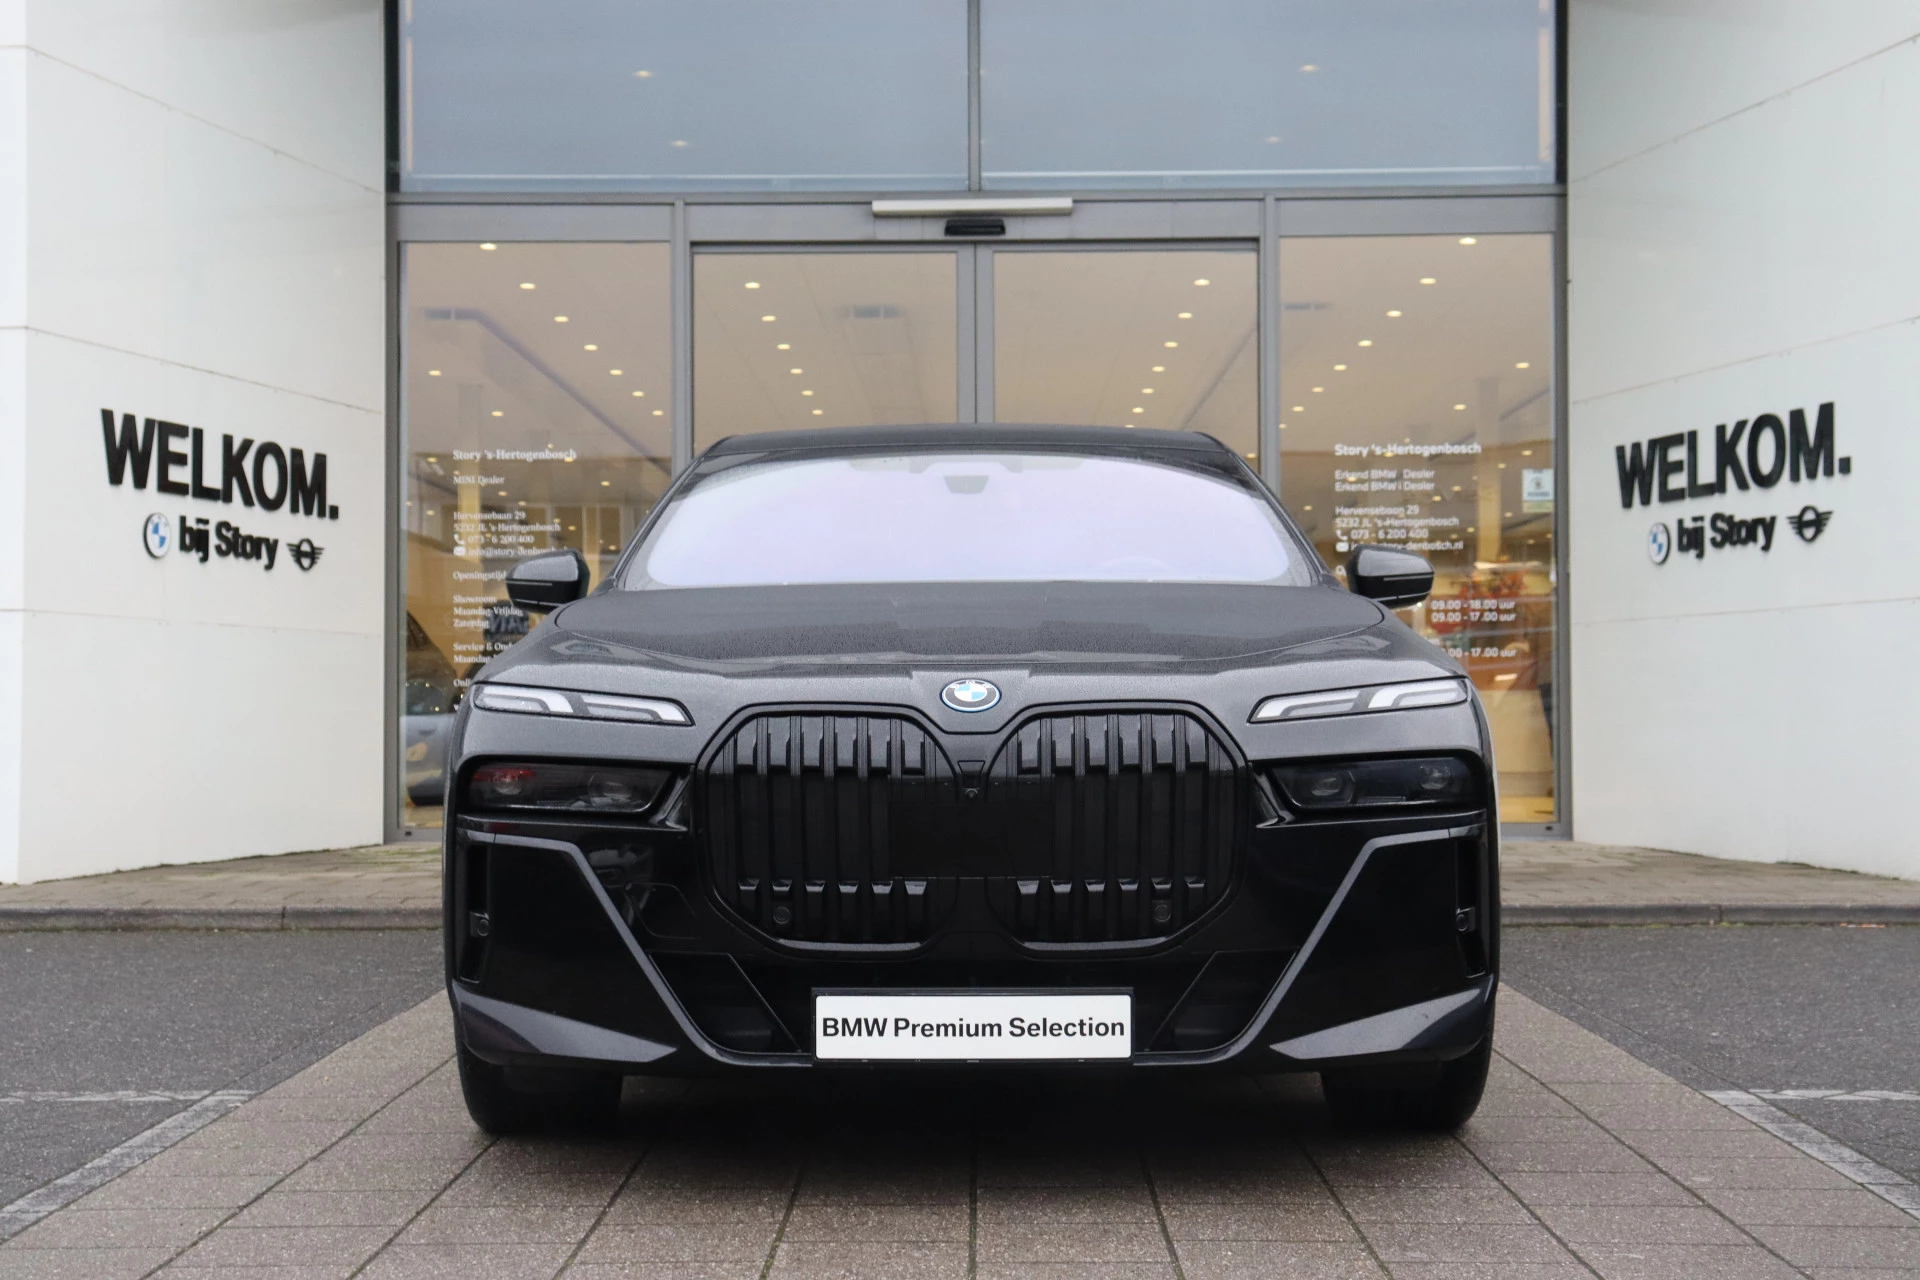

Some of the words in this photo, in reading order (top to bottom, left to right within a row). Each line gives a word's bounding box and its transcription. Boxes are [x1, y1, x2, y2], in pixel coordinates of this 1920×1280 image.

[452, 449, 481, 462] Story
[1334, 443, 1369, 457] Story
[1615, 401, 1852, 509] WELKOM.
[101, 408, 339, 520] WELKOM.
[453, 476, 476, 484] MINI
[478, 475, 505, 484] Dealer
[1334, 469, 1369, 480] Erkend
[1371, 469, 1397, 480] BMW
[1403, 469, 1435, 480] Dealer
[1334, 482, 1369, 492] Erkend
[1371, 481, 1397, 491] BMW
[1403, 481, 1435, 491] Dealer
[1406, 504, 1420, 515] 29
[514, 511, 526, 520] 29
[1335, 517, 1360, 528] 5232
[1351, 529, 1370, 539] 073
[1378, 529, 1385, 539] 6
[1387, 529, 1407, 539] 200
[1408, 528, 1429, 538] 400
[1677, 515, 1705, 559] bij
[1710, 513, 1777, 552] Story
[179, 515, 210, 563] bij
[214, 520, 279, 571] Story
[453, 571, 507, 581] Openingstijd
[452, 595, 497, 603] Showroom
[1431, 600, 1461, 610] 09.00
[1499, 601, 1516, 609] uur
[1431, 612, 1461, 622] 09.00
[1499, 613, 1516, 621] uur
[453, 619, 489, 629] Zaterdag
[453, 642, 485, 651] Service
[1500, 649, 1517, 657] uur
[822, 1017, 888, 1037] BMW
[894, 1017, 1002, 1037] Premium
[1008, 1016, 1125, 1037] Selection
